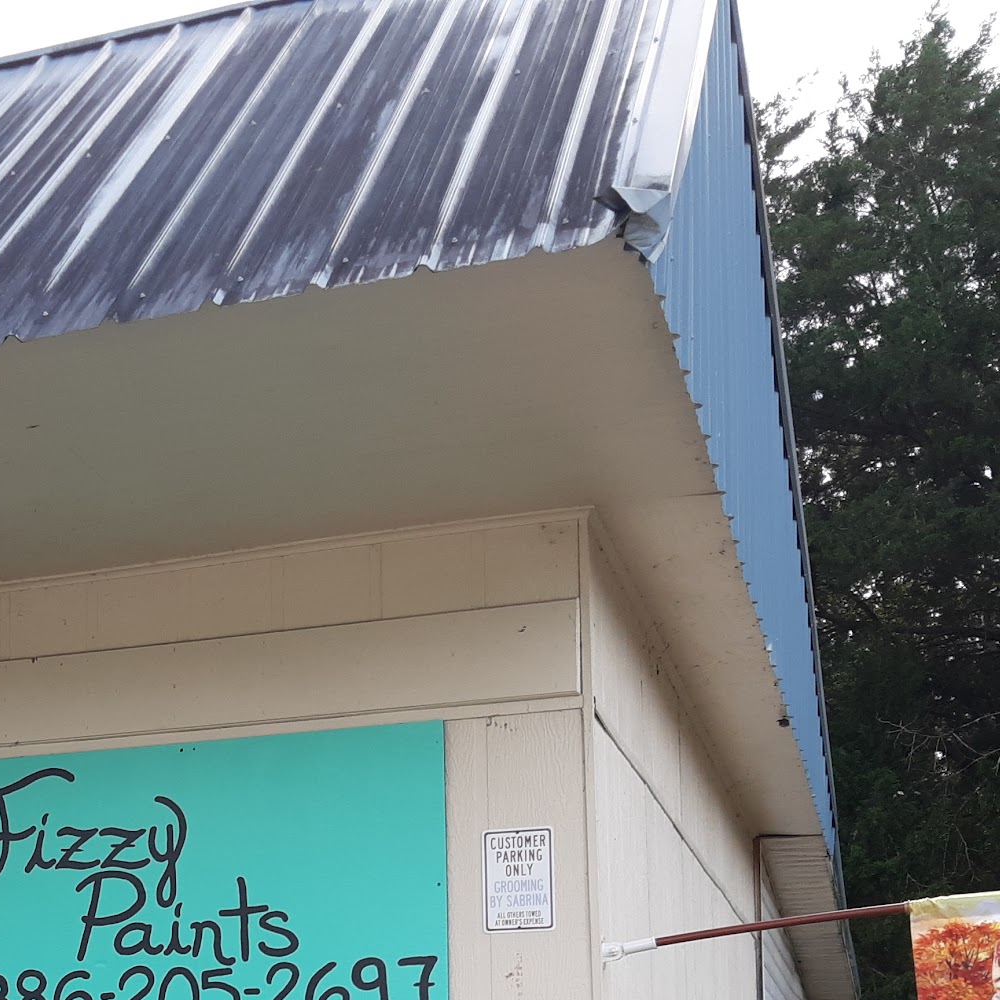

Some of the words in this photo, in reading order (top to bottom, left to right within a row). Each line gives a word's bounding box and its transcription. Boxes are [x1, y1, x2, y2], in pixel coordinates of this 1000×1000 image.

[490, 834, 546, 850] CUSTOMER
[496, 848, 543, 863] PARKING
[505, 863, 533, 877] ONLY
[494, 879, 544, 893] GROOMING
[490, 895, 502, 908] BY
[506, 893, 549, 907] SABRINA
[75, 870, 299, 964] Paints
